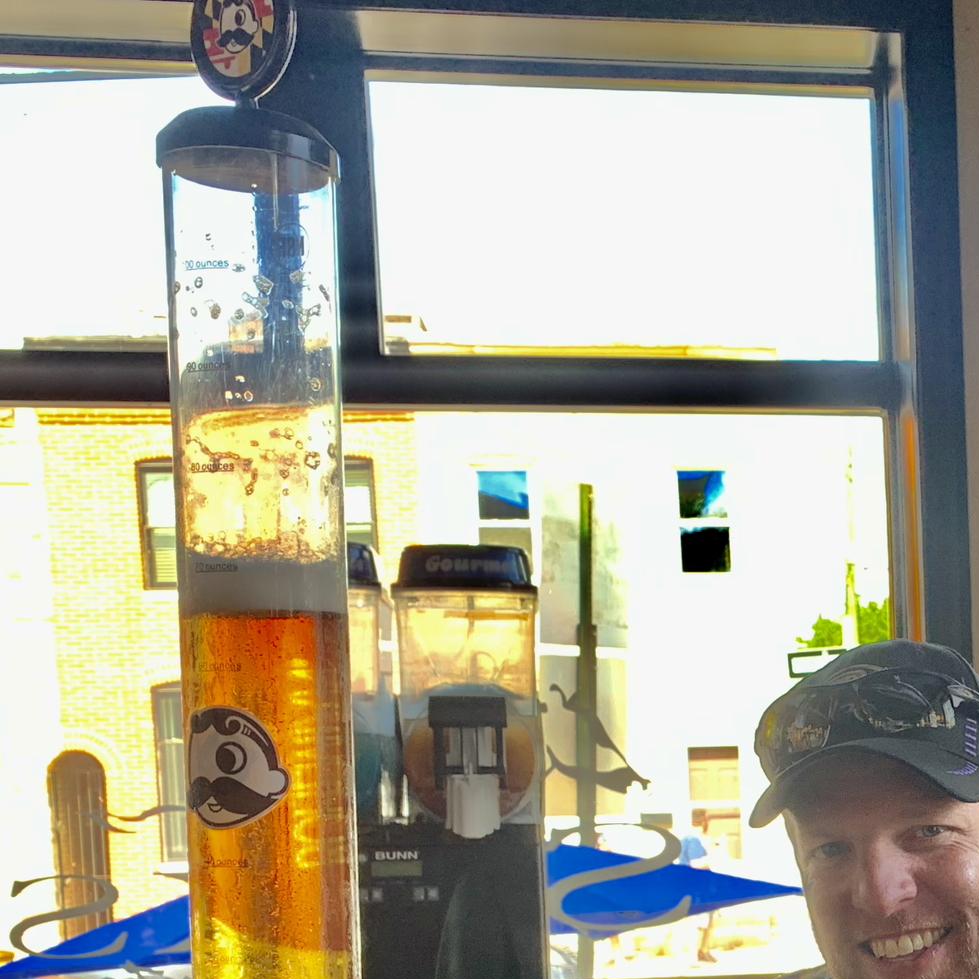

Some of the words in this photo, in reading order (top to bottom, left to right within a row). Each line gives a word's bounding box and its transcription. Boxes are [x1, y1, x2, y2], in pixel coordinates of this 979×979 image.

[195, 259, 230, 269] ounces
[191, 463, 202, 472] 80
[202, 463, 235, 472] ounces
[204, 562, 238, 572] ounces
[374, 850, 419, 861] BUNN
